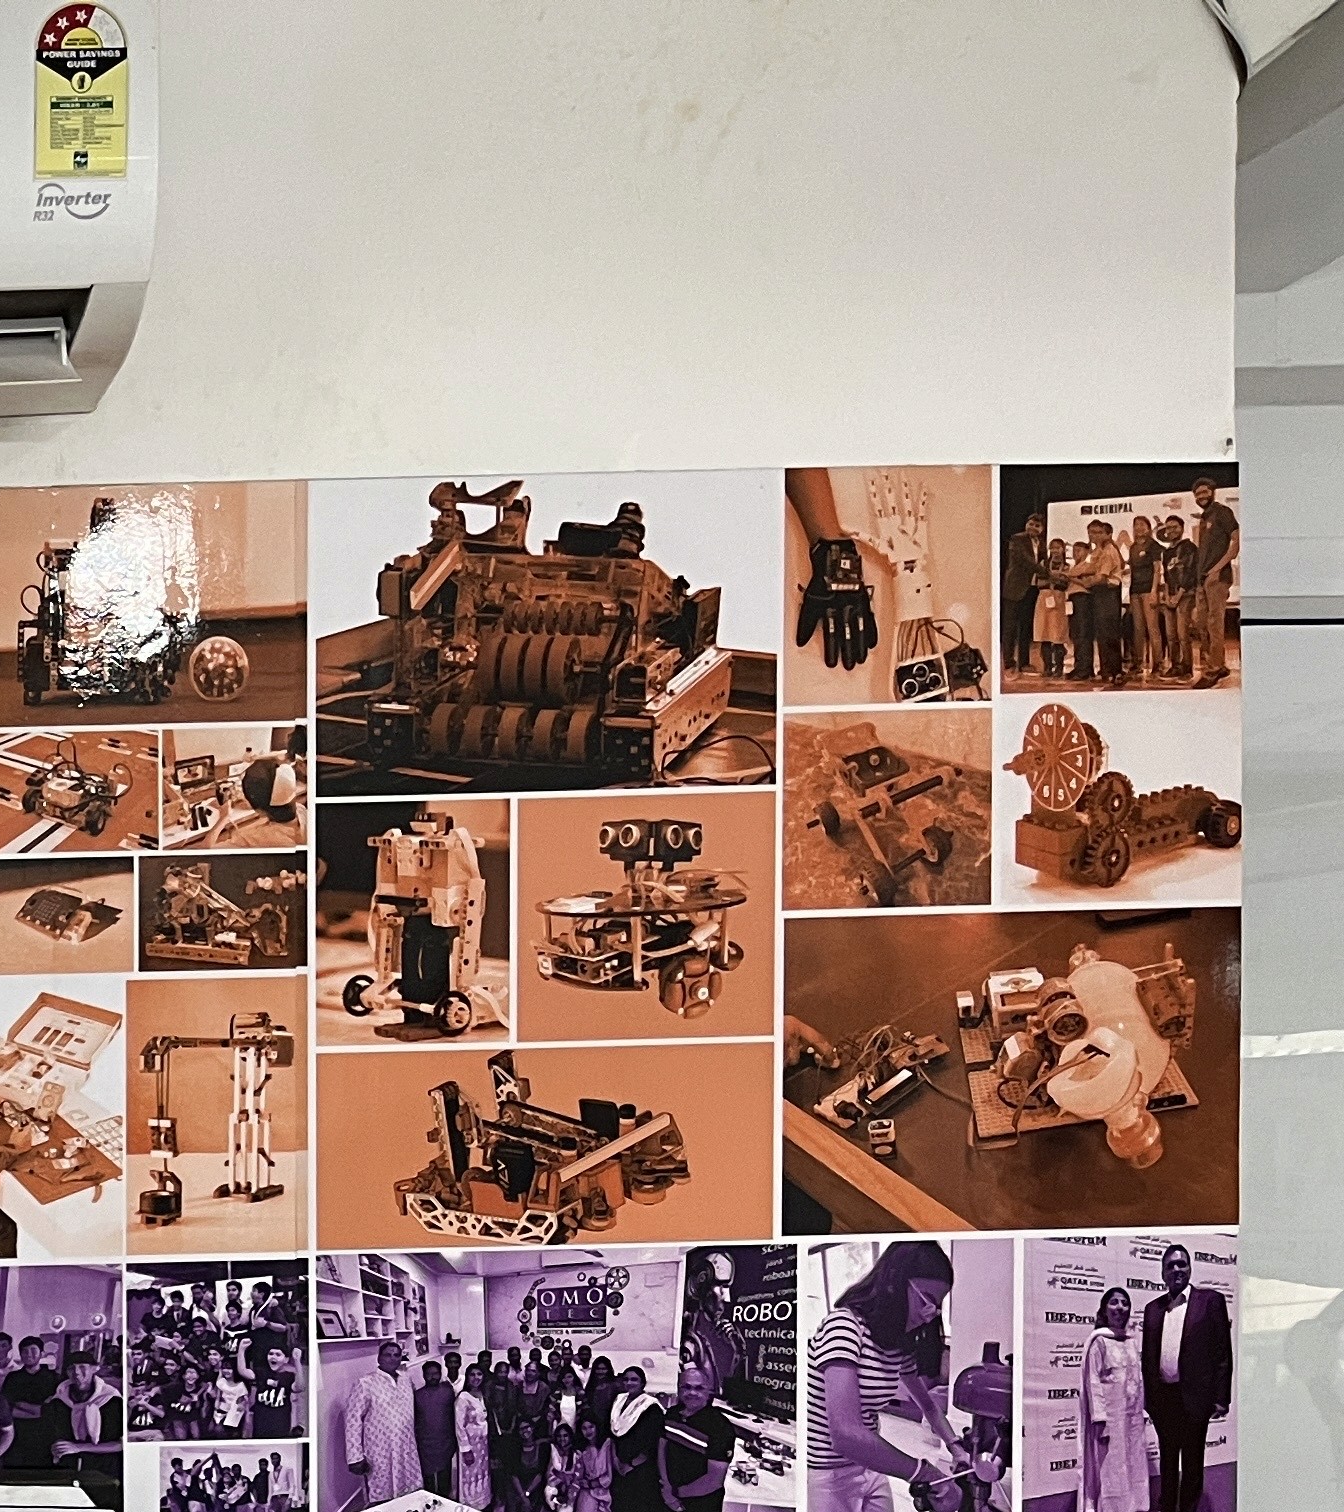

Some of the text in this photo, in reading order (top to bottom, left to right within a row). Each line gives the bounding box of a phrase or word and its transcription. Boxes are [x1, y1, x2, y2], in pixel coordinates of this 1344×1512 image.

[66, 60, 97, 68] GUIDE
[36, 191, 112, 208] Inverter
[32, 210, 55, 222] R32
[1060, 1276, 1089, 1287] QATAR
[540, 1287, 604, 1307] OMO
[544, 1307, 601, 1320] TEC
[1068, 1312, 1096, 1325] Foru
